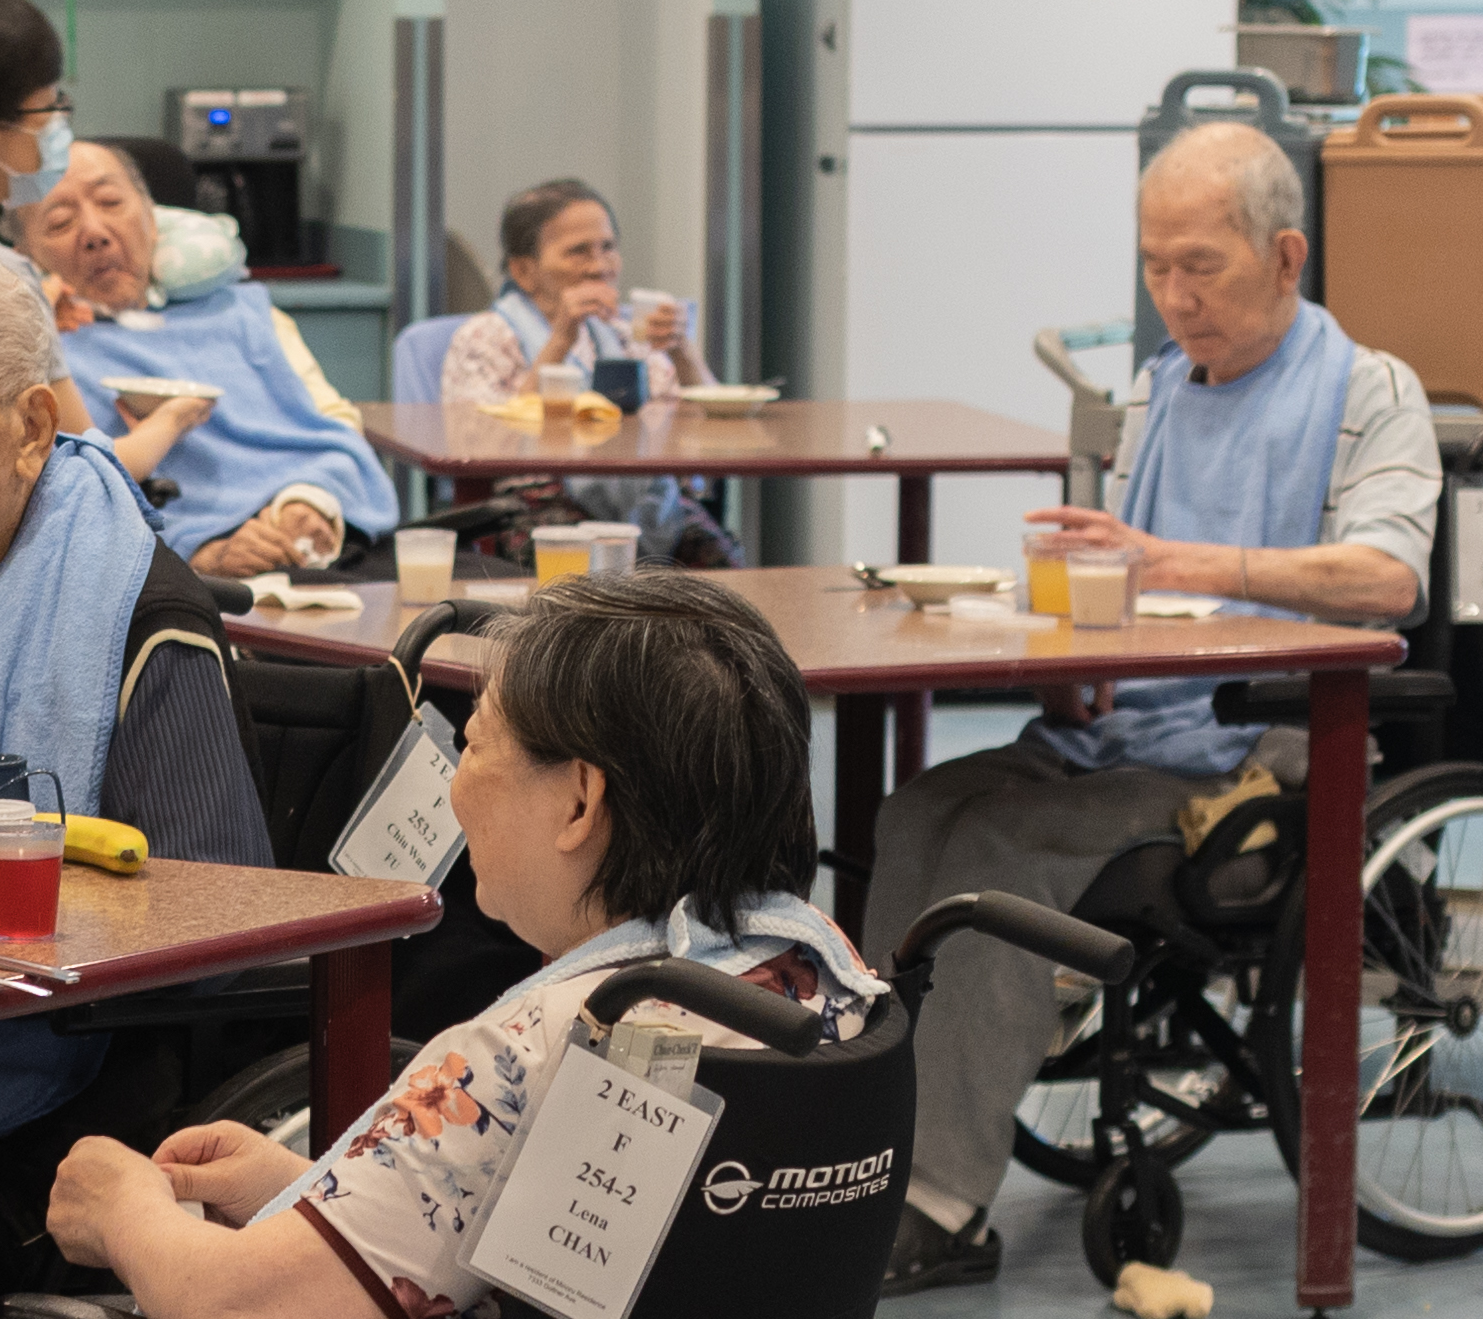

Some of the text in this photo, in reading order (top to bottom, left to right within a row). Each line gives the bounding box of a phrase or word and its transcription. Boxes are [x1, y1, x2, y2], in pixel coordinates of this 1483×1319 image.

[430, 753, 440, 768] 2
[433, 796, 445, 810] F
[384, 852, 401, 871] FU
[387, 823, 427, 872] Chiu Wan
[596, 1079, 685, 1135] 2 EAST
[612, 1132, 632, 1154] F
[575, 1161, 637, 1206] 254-2
[767, 1148, 894, 1189] MOTION
[761, 1173, 890, 1209] COMPOSITES
[568, 1199, 609, 1232] Lena
[548, 1224, 612, 1268] CHAN
